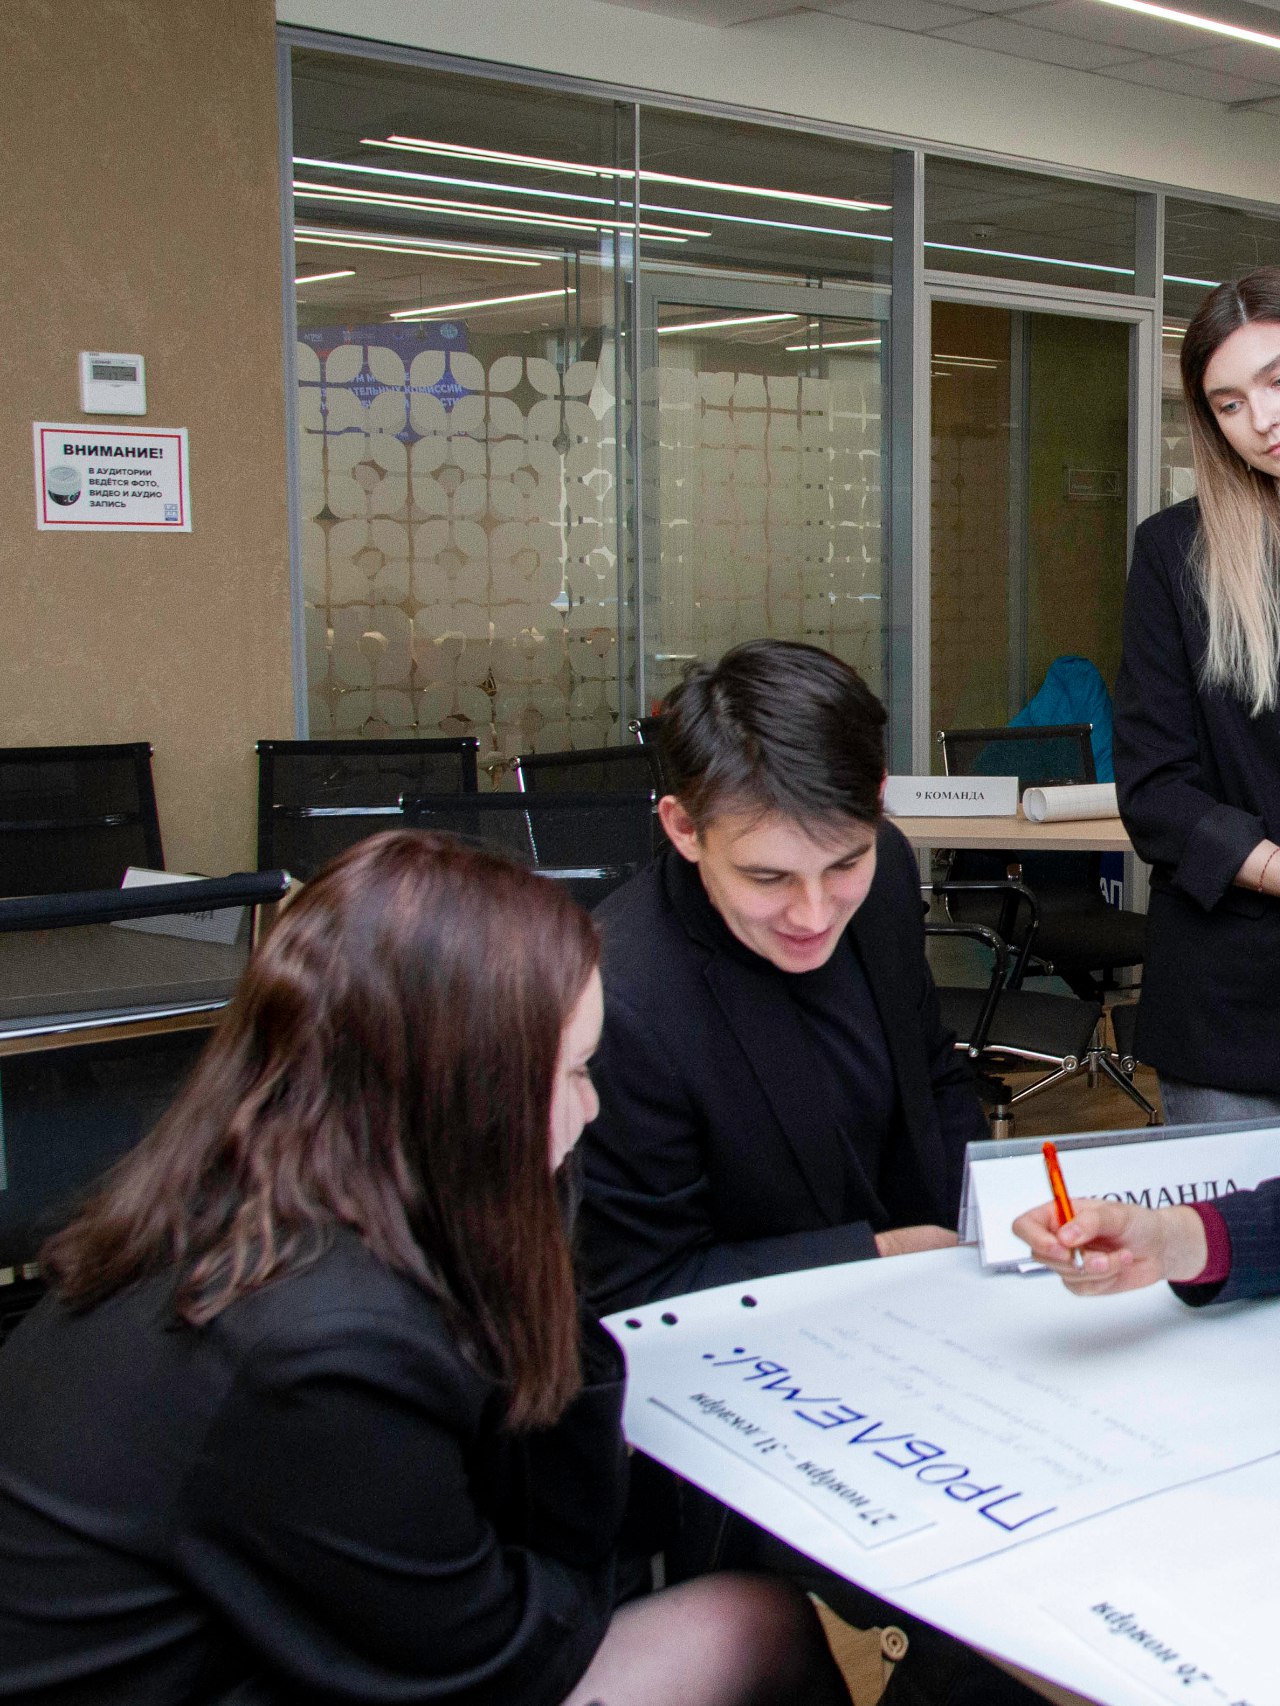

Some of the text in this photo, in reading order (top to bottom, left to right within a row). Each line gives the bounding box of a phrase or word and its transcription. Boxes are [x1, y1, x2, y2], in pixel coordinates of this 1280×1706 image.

[63, 444, 163, 459] ВНИМАНИЕ!
[97, 468, 152, 476] АУДИТОРИИ
[89, 478, 129, 486] ВЕДЁТСЯ
[89, 489, 121, 497] ВИДЕО
[90, 500, 127, 508] ЗАПИСЬ
[915, 791, 985, 801] 9 КОМАНДА
[702, 1346, 1058, 1531] ПРОБЛЕМЫ:
[796, 1460, 870, 1508] ноября
[858, 1507, 897, 1526] 27
[1090, 1601, 1179, 1664] ноября
